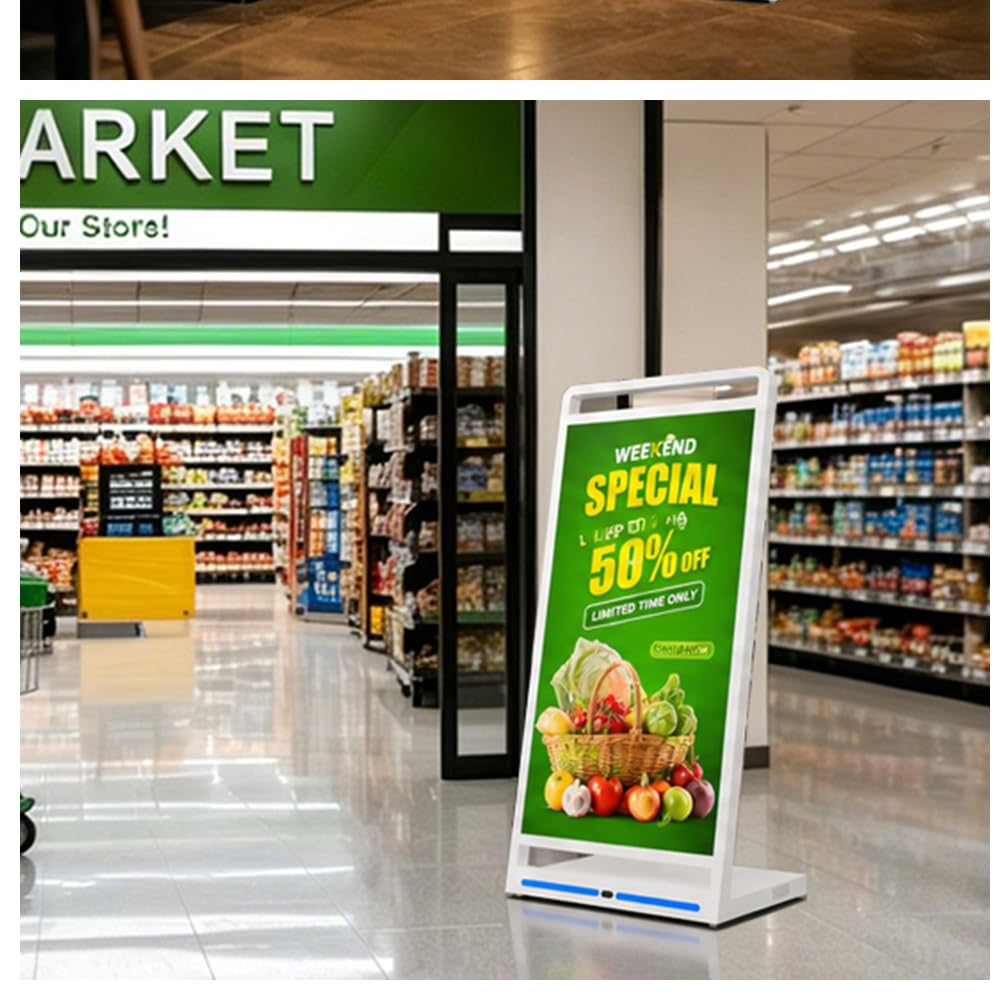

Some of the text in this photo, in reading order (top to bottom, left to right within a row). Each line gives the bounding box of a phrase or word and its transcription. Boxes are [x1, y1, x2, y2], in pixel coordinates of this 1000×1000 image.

[20, 213, 169, 238] Our Store!
[614, 437, 697, 464] WEEKEND
[584, 462, 719, 517] SPECIAL
[589, 528, 678, 596] 50%
[681, 546, 712, 573] OFF
[591, 589, 699, 621] LIMITED TIME ONLY
